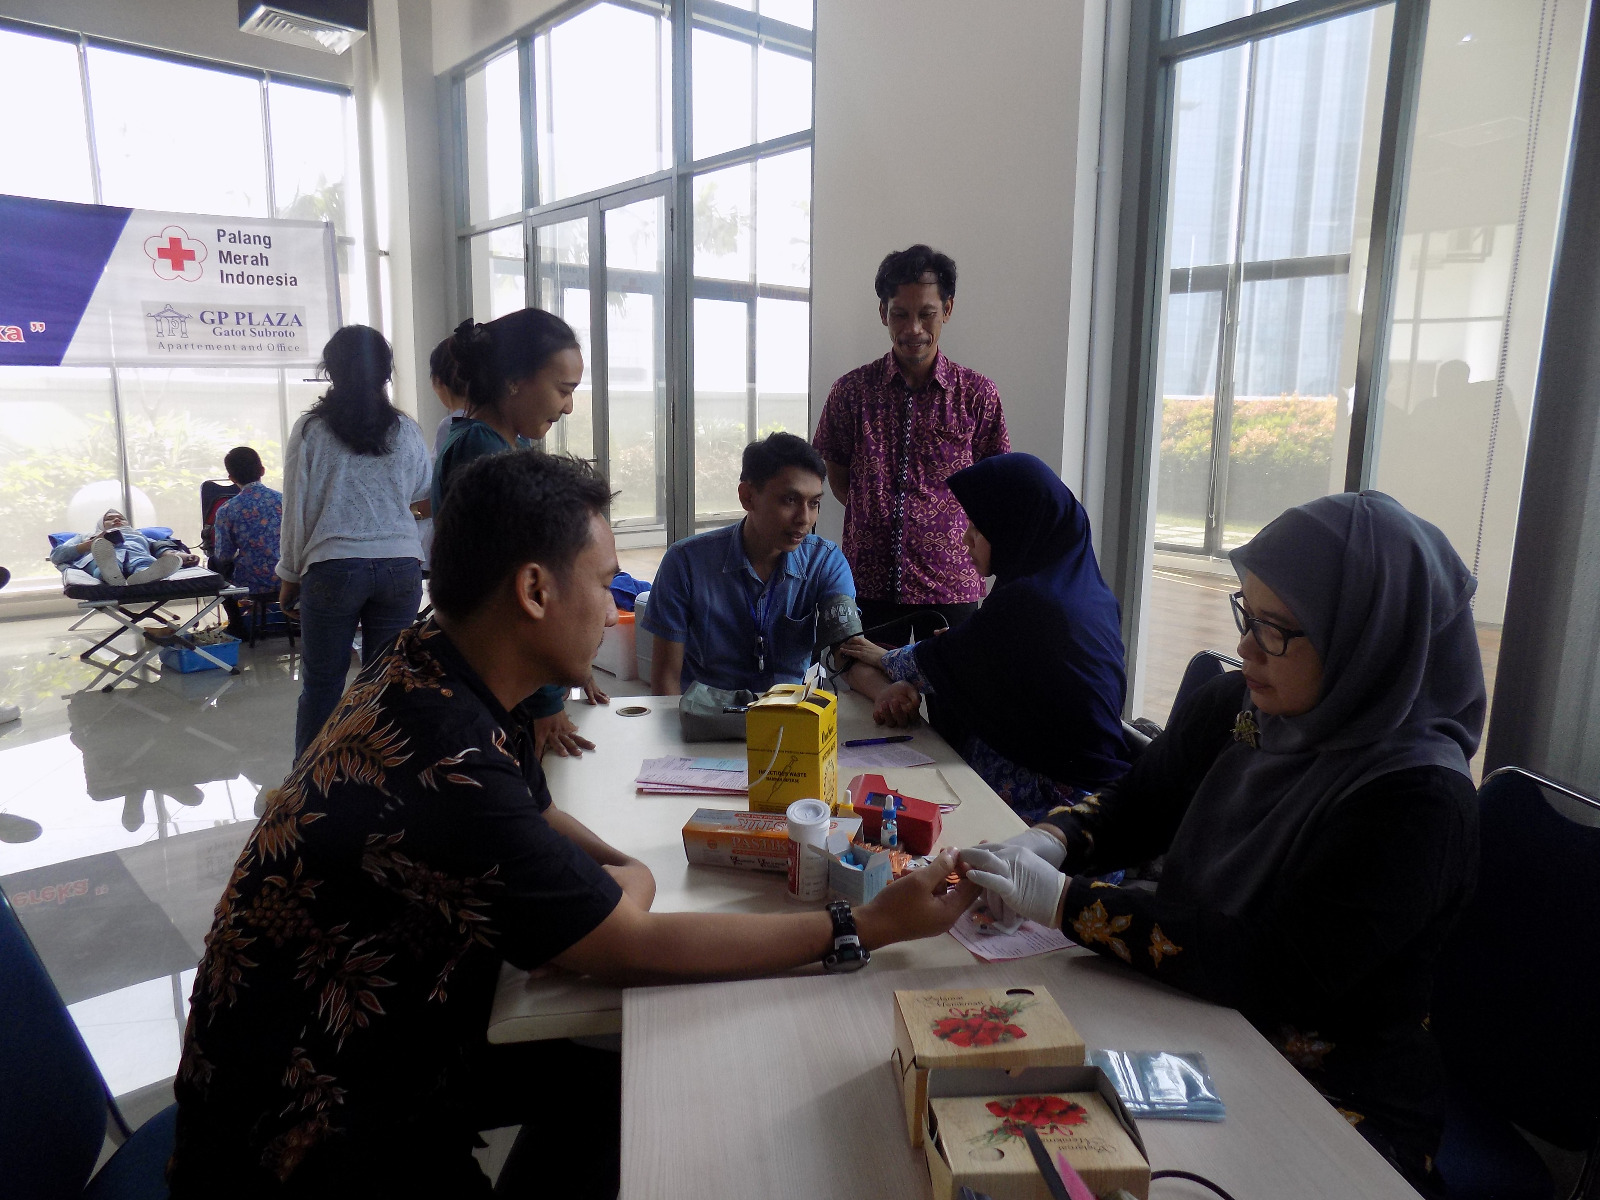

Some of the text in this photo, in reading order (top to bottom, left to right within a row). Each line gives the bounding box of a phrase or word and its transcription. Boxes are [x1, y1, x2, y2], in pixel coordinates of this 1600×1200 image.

[217, 228, 272, 249] Palang
[218, 250, 269, 267] Merah
[220, 269, 298, 287] Indonesia
[199, 310, 303, 328] GP PLAZA
[212, 326, 296, 339] Gatot Subroto
[158, 341, 300, 352] Apartement and Office
